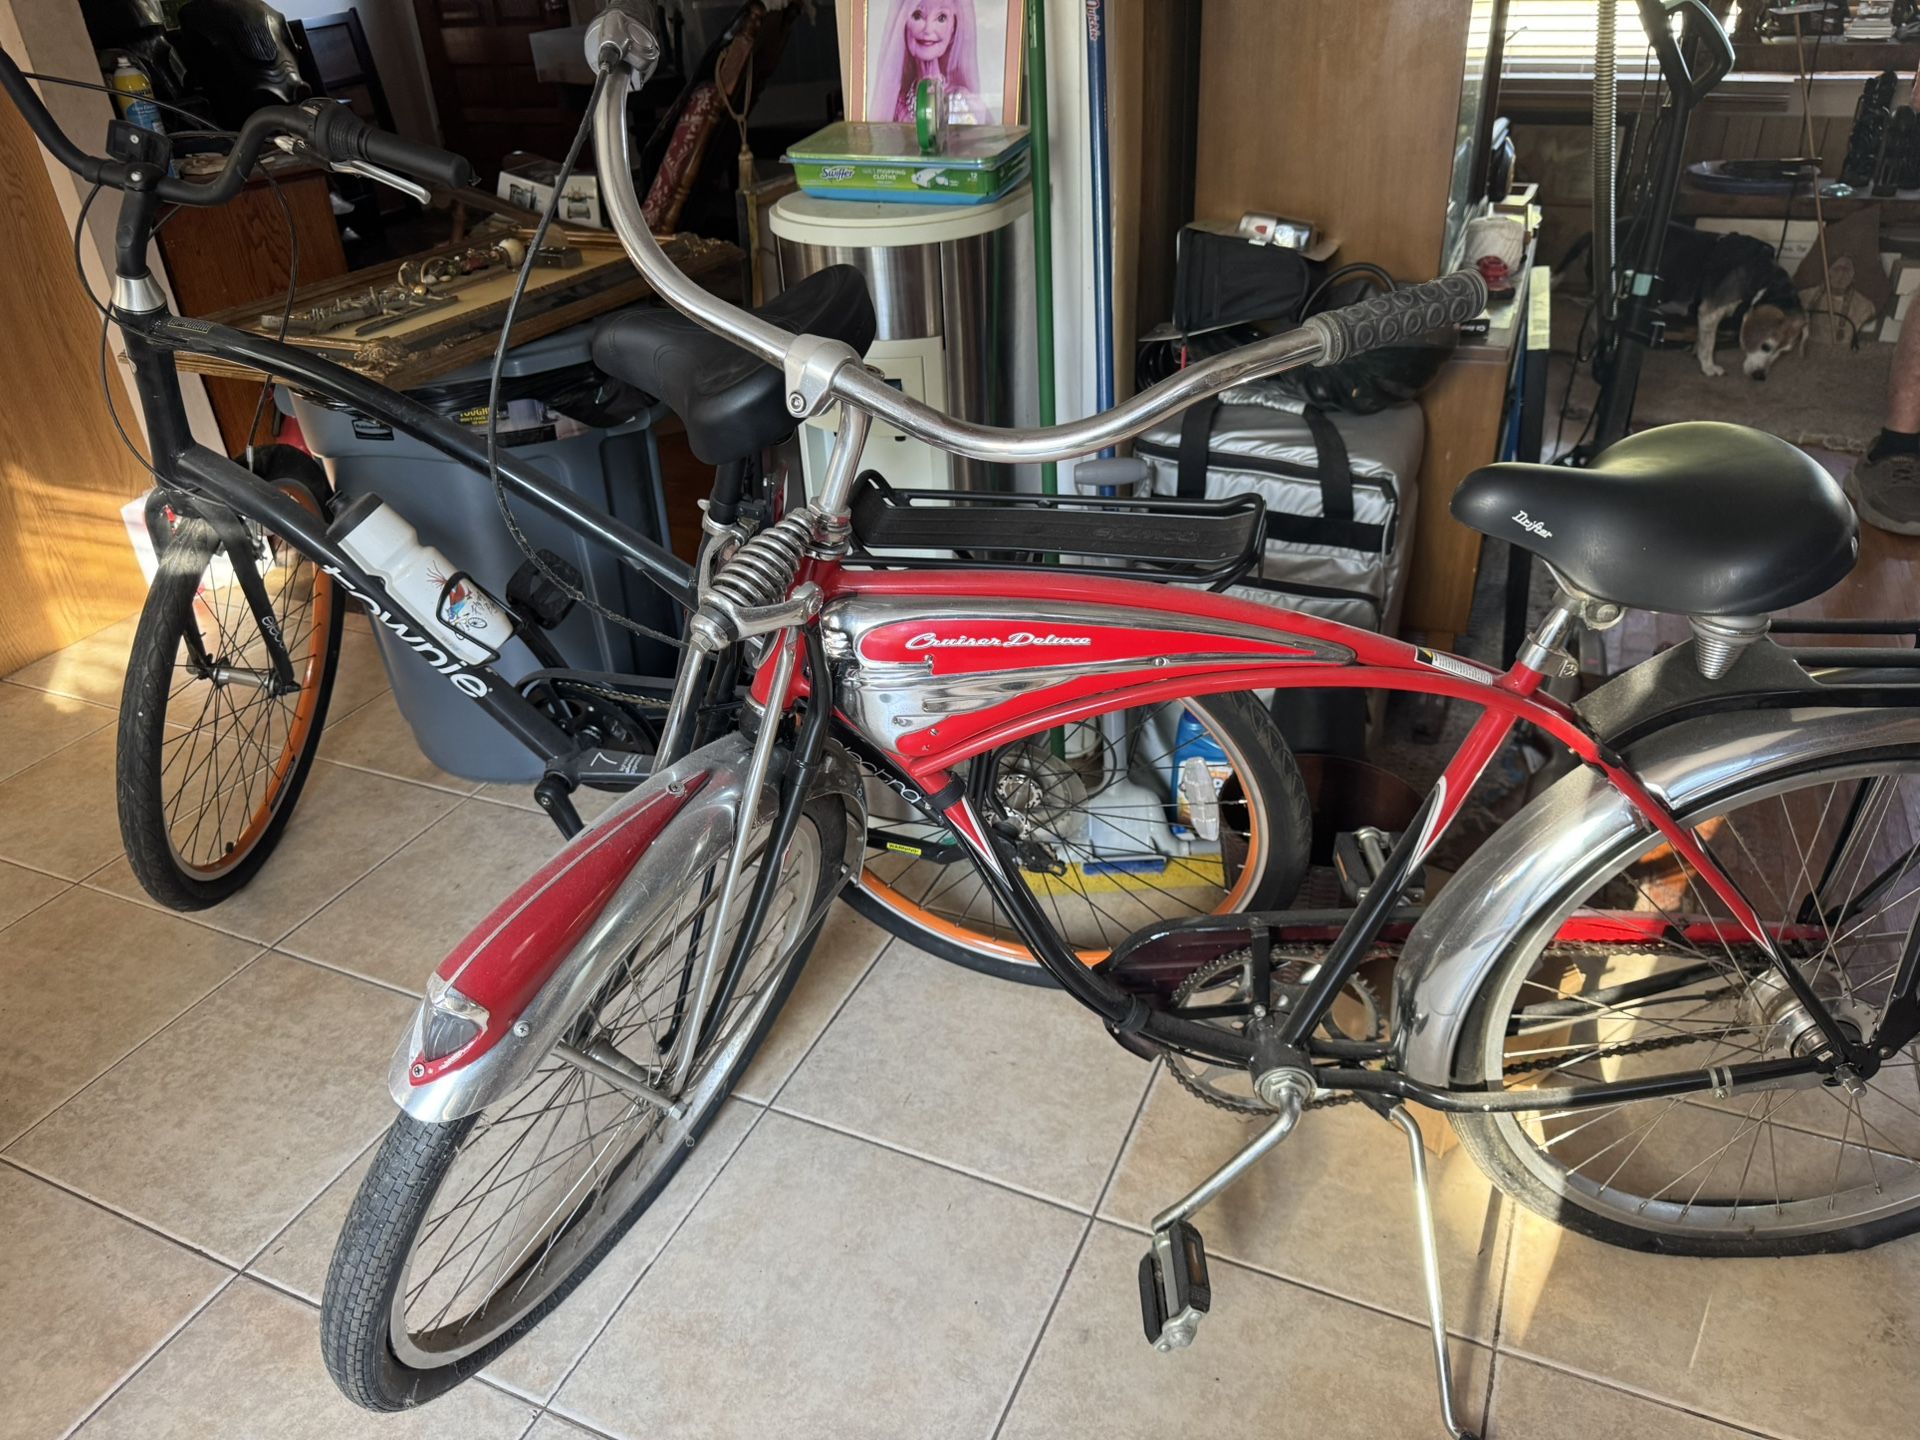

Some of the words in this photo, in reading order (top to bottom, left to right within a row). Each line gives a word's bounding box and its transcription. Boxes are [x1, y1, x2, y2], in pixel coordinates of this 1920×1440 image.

[821, 165, 856, 181] Swiffer
[1512, 510, 1552, 538] Drifter
[321, 564, 488, 698] townie
[905, 632, 1001, 650] Cruiser
[1002, 632, 1092, 648] Deluxe
